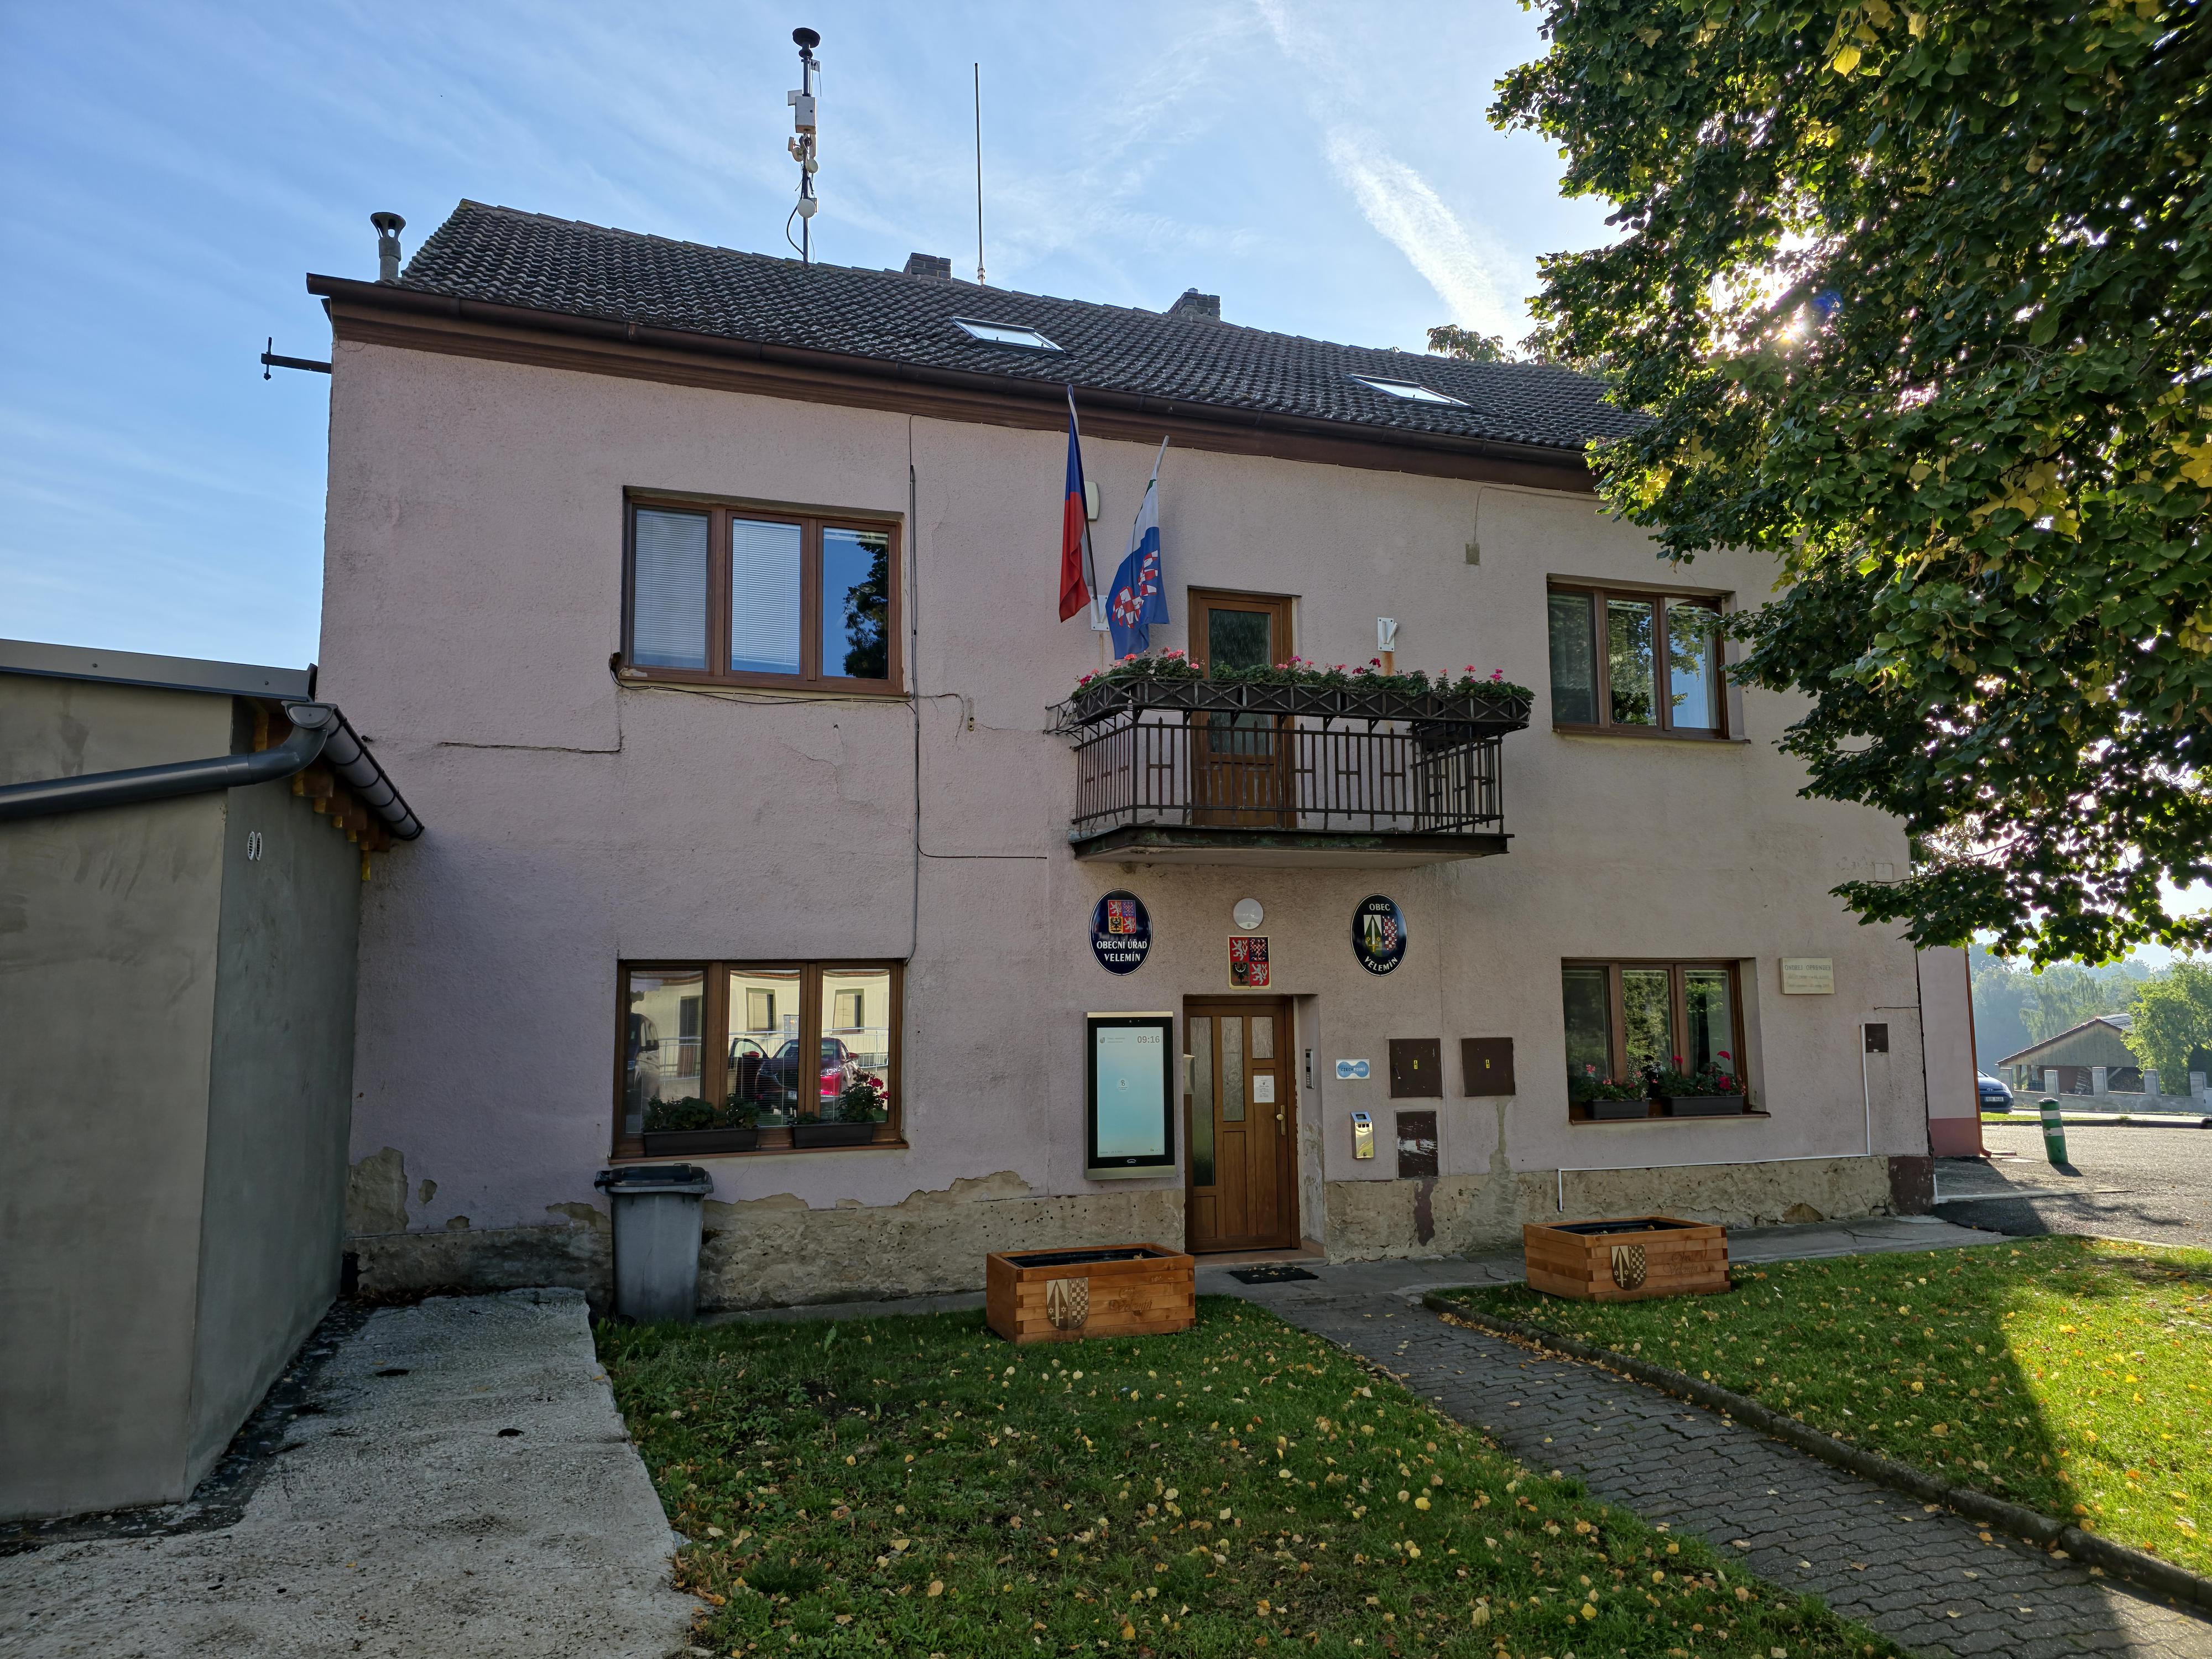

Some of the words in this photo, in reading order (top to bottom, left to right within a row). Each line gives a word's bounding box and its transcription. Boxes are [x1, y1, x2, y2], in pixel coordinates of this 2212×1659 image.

[1369, 903, 1390, 911] OBEC
[1096, 939, 1125, 949] OBECNÍ
[1128, 939, 1147, 949] ÚŘAD
[1104, 951, 1140, 962] VELEMÍN
[1364, 956, 1398, 972] VELEMÍN
